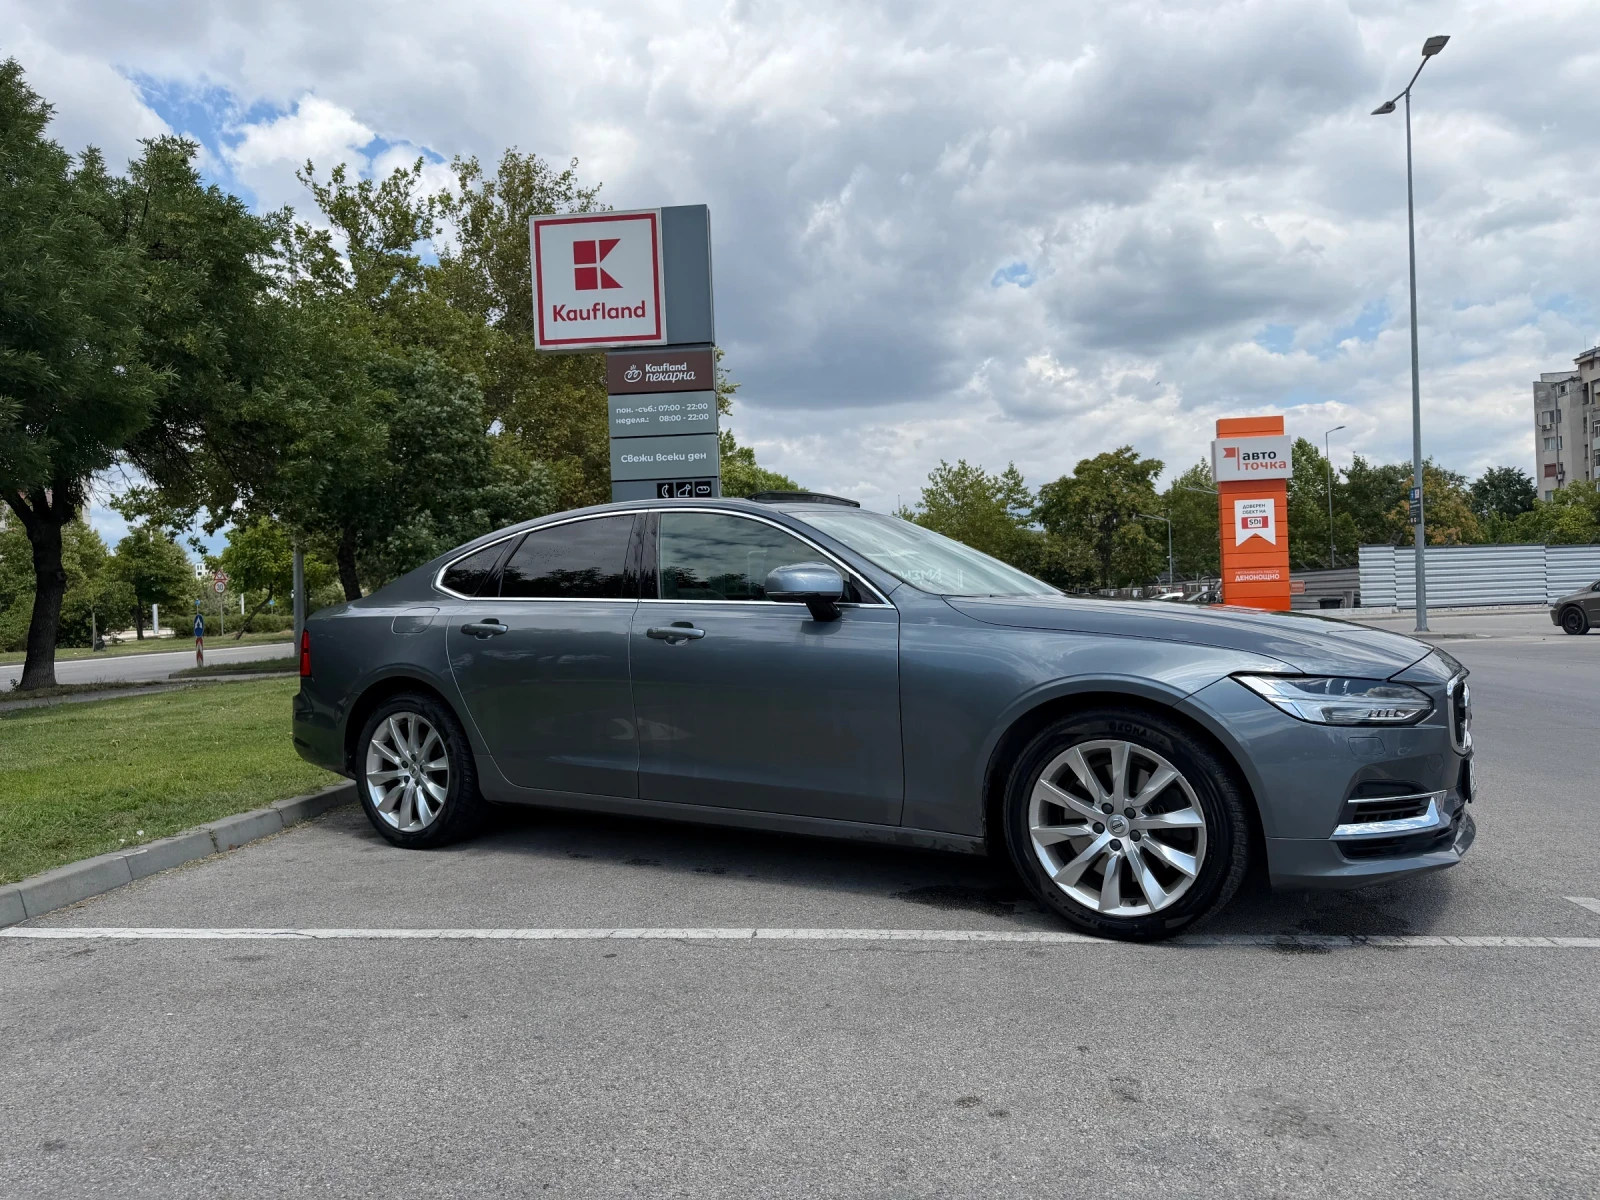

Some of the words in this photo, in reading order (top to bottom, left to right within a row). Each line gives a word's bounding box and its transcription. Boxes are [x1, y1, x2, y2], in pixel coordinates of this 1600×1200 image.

[552, 300, 646, 322] Kaufland
[645, 362, 687, 372] Kaufland
[645, 371, 696, 383] пекарна
[658, 404, 681, 412] 07:00
[659, 414, 682, 422] 08:00
[687, 413, 709, 421] 22:00
[621, 453, 654, 463] Свежи
[656, 452, 685, 462] всеки
[687, 452, 707, 462] ден
[1242, 451, 1277, 461] авто
[1243, 460, 1287, 470] точка
[1235, 573, 1280, 582] ДЕНОНОЩНО
